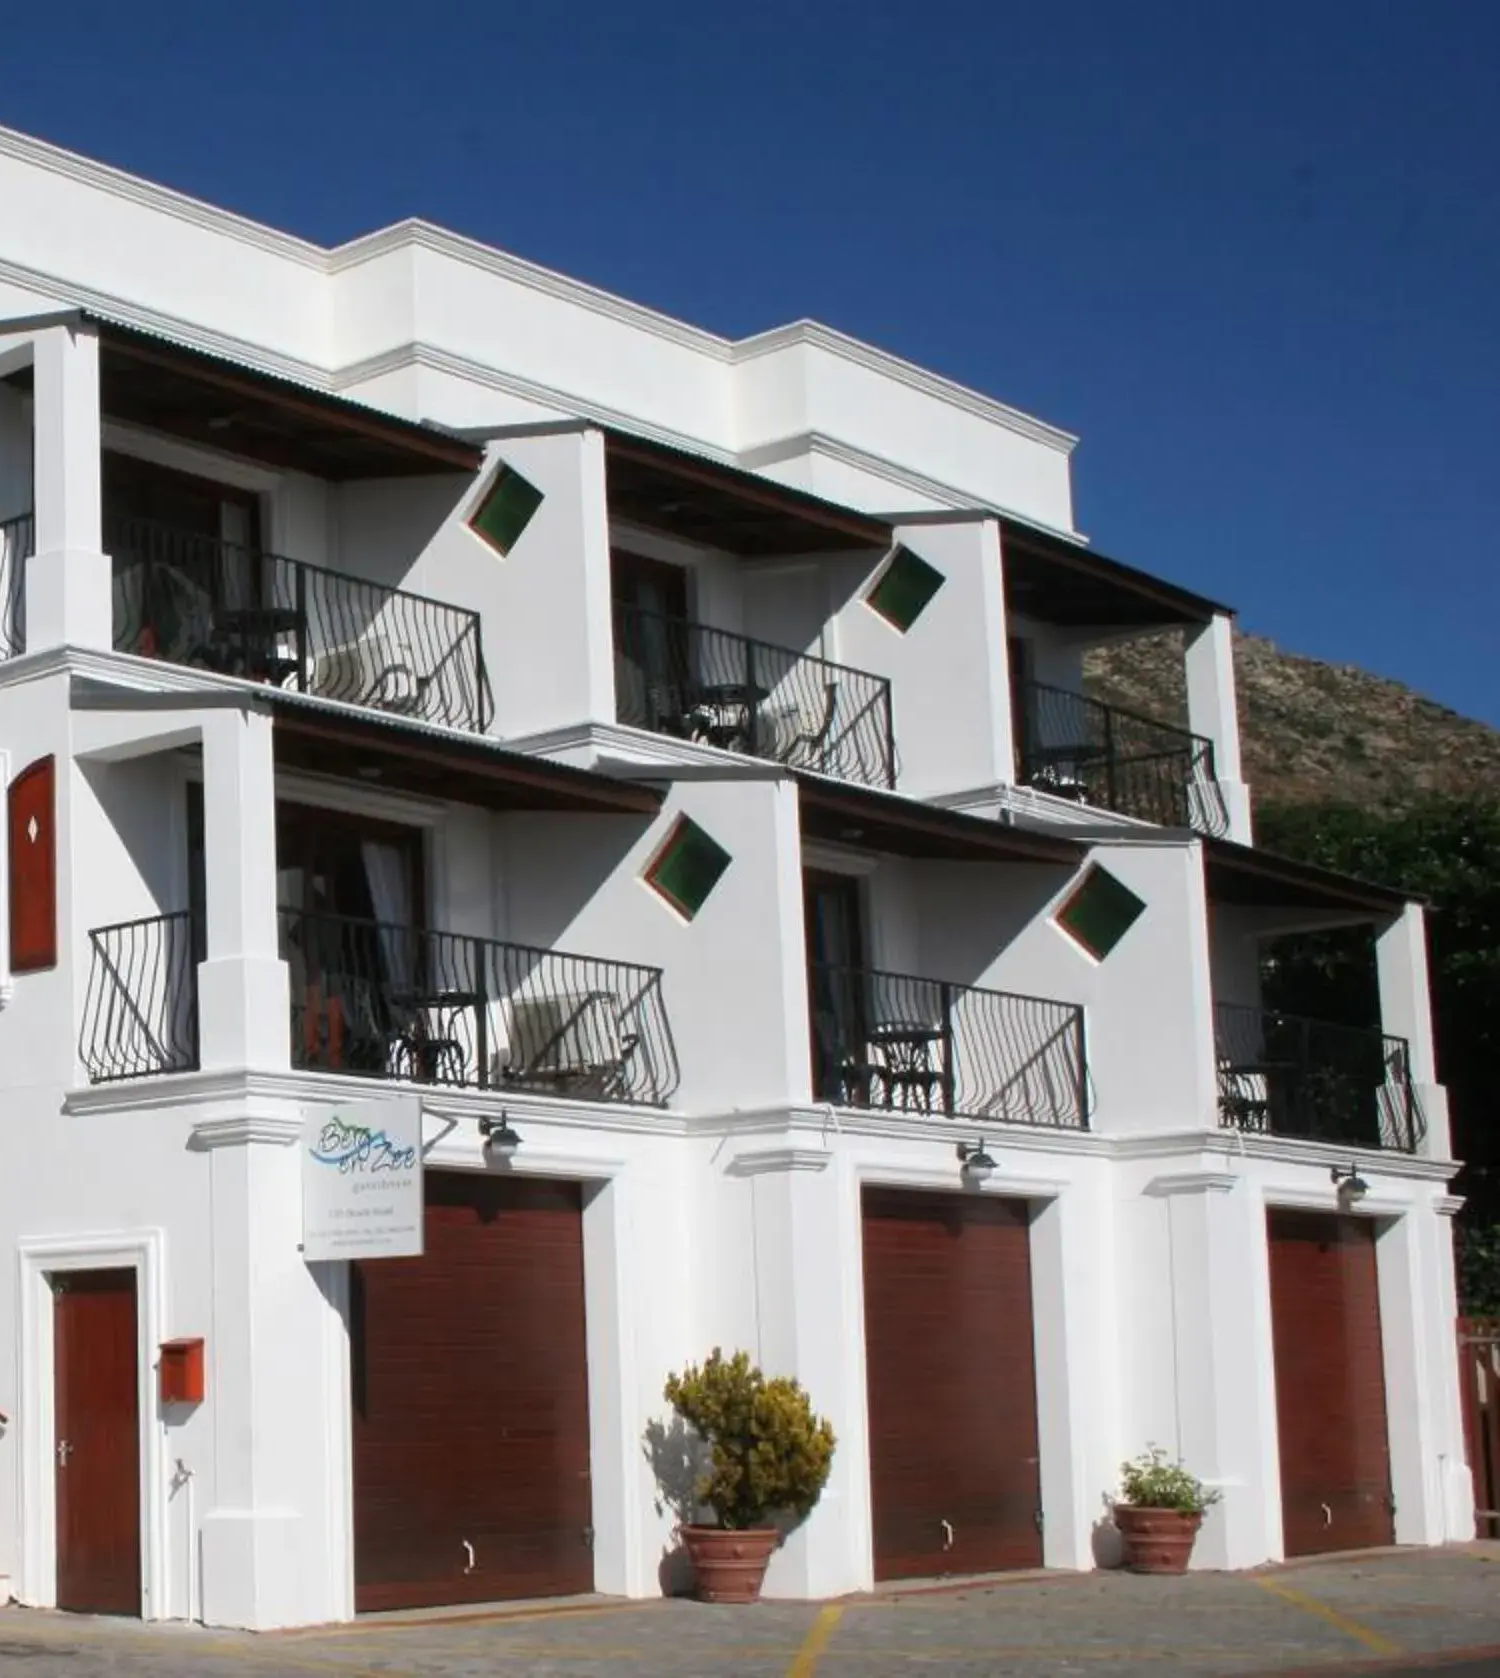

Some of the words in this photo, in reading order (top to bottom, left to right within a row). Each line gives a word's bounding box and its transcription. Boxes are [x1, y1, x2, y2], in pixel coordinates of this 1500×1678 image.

[319, 1124, 370, 1163] Berg
[339, 1152, 365, 1174] en
[372, 1142, 417, 1173] Zee
